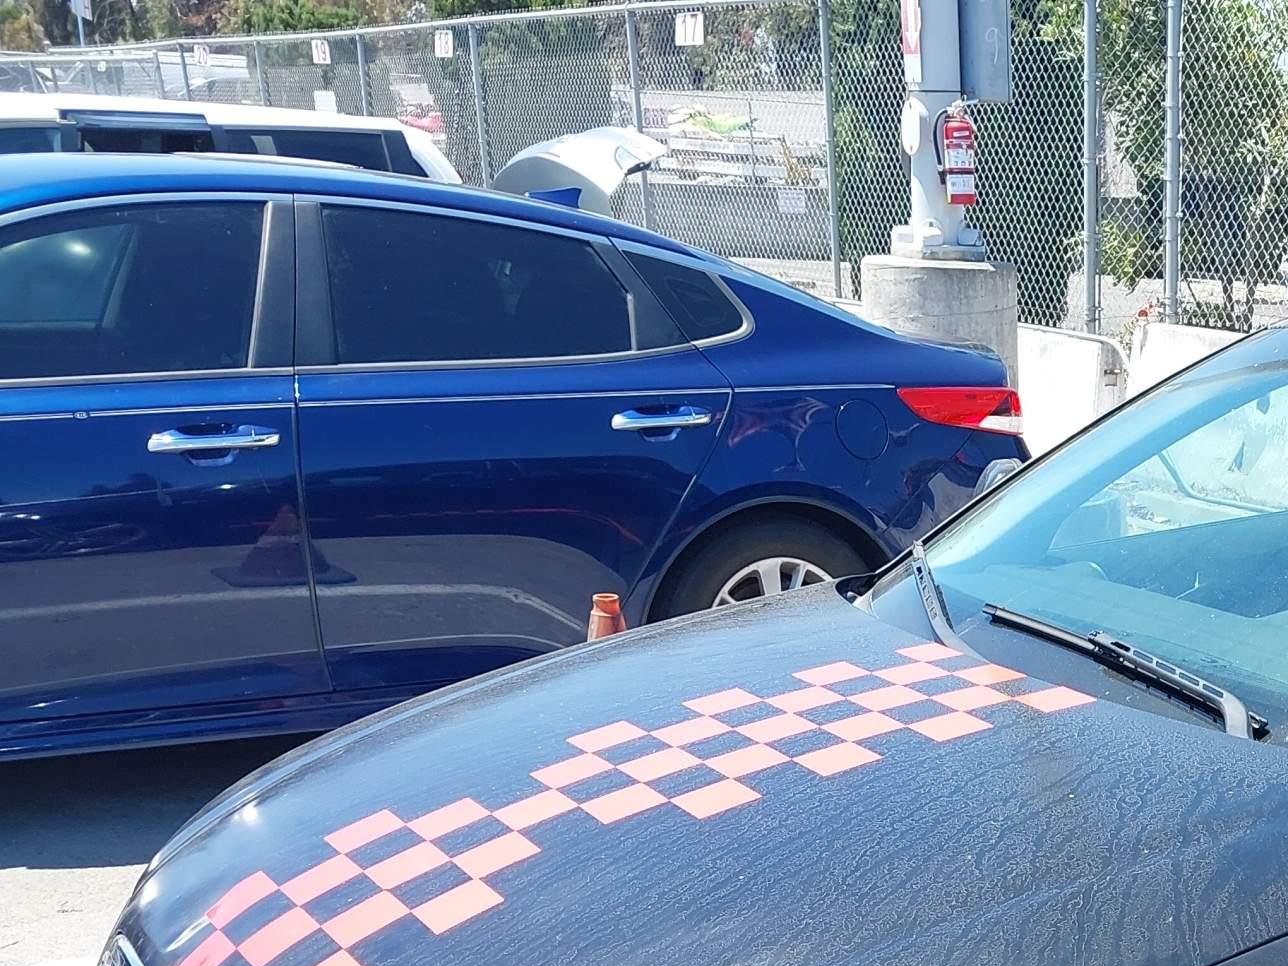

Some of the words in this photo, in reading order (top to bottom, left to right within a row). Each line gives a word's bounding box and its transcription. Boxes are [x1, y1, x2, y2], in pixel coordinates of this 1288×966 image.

[680, 14, 699, 42] 17
[316, 41, 328, 62] 19
[438, 32, 450, 55] 18
